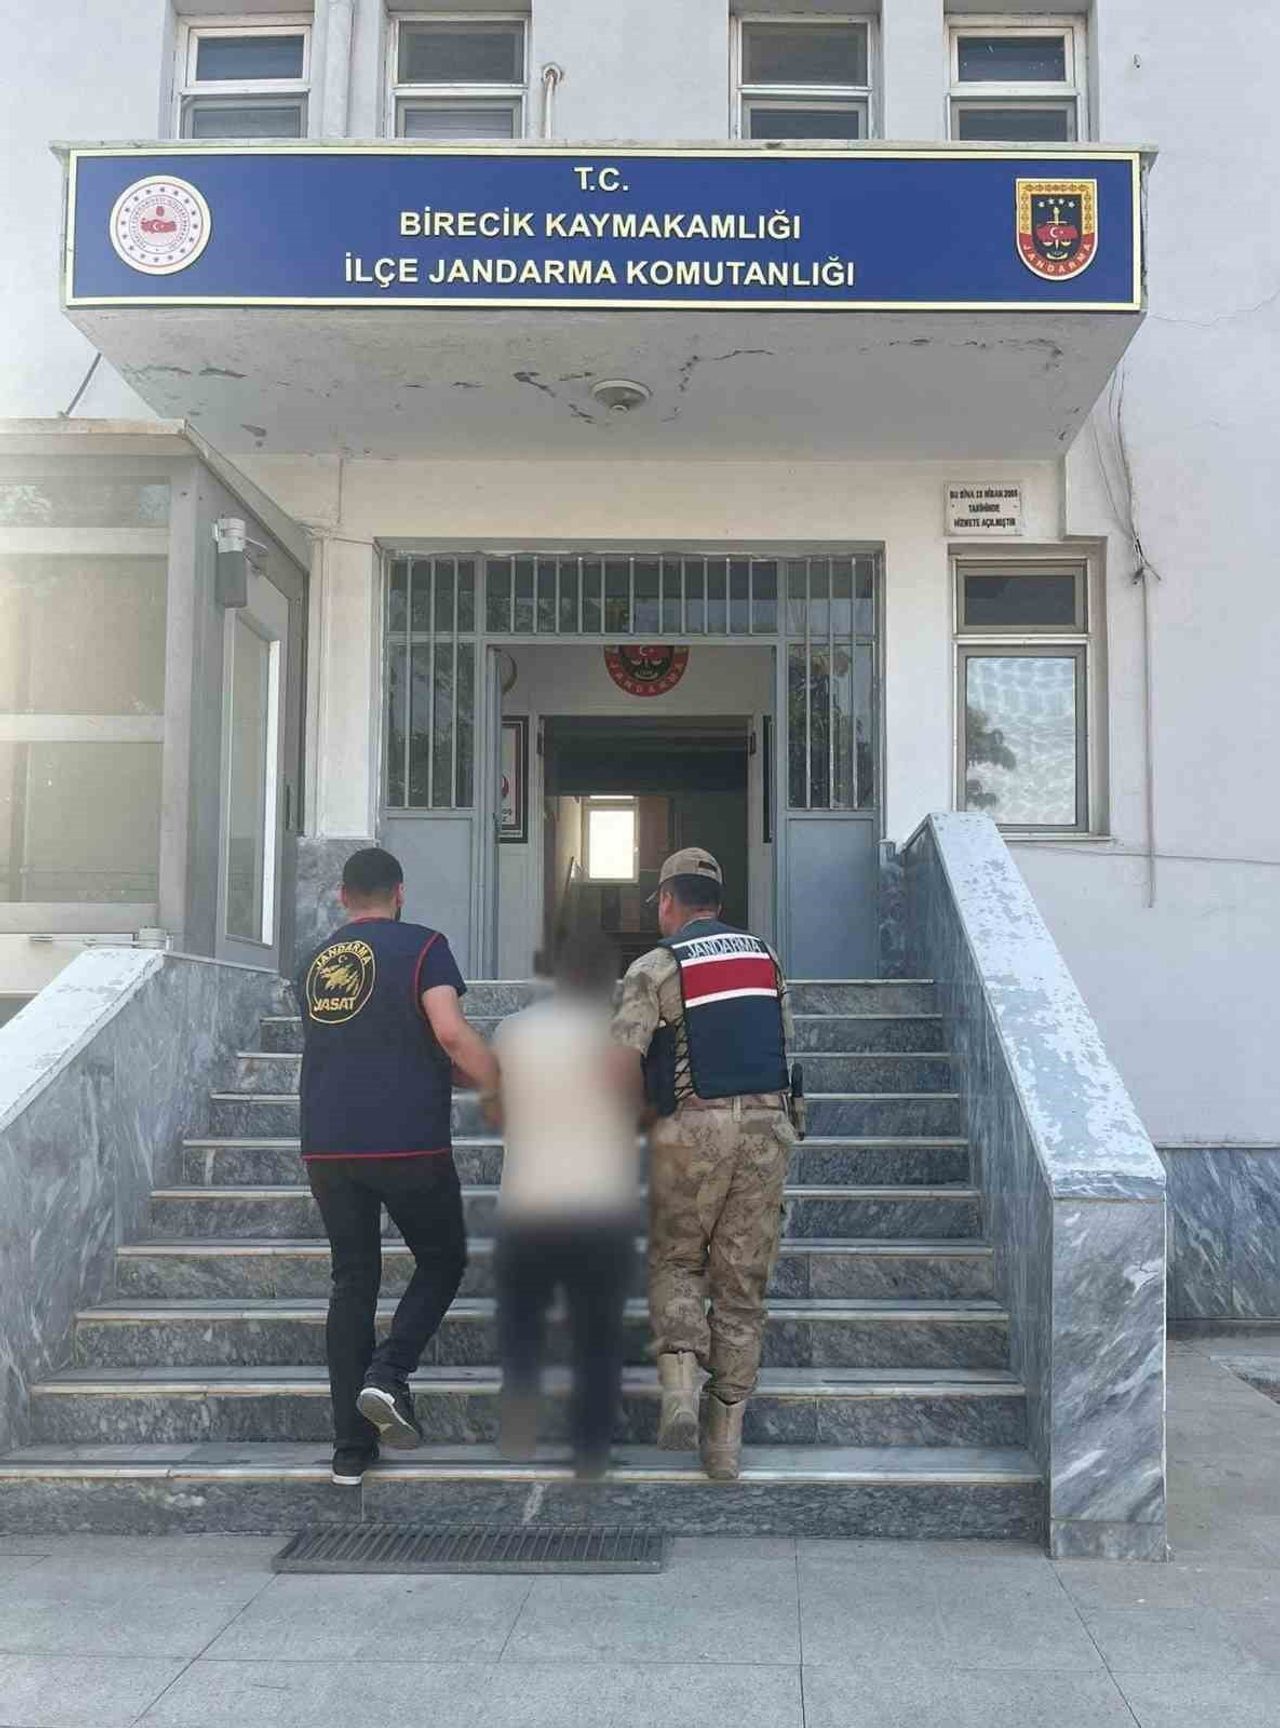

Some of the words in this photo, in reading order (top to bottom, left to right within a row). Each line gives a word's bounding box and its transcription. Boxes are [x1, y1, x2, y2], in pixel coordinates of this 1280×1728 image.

[574, 166, 629, 191] T.C.
[400, 206, 535, 237] BİRECİK
[545, 208, 801, 240] KAYMAKAMLIĞI
[345, 252, 418, 288] İLÇE
[428, 259, 617, 284] JANDARMA
[626, 256, 855, 287] KOMUTANLIĞI
[1023, 243, 1092, 274] JANDARMA
[315, 942, 372, 969] JANDARMA
[686, 936, 761, 959] JANDARMA
[313, 996, 356, 1012] JASAT
